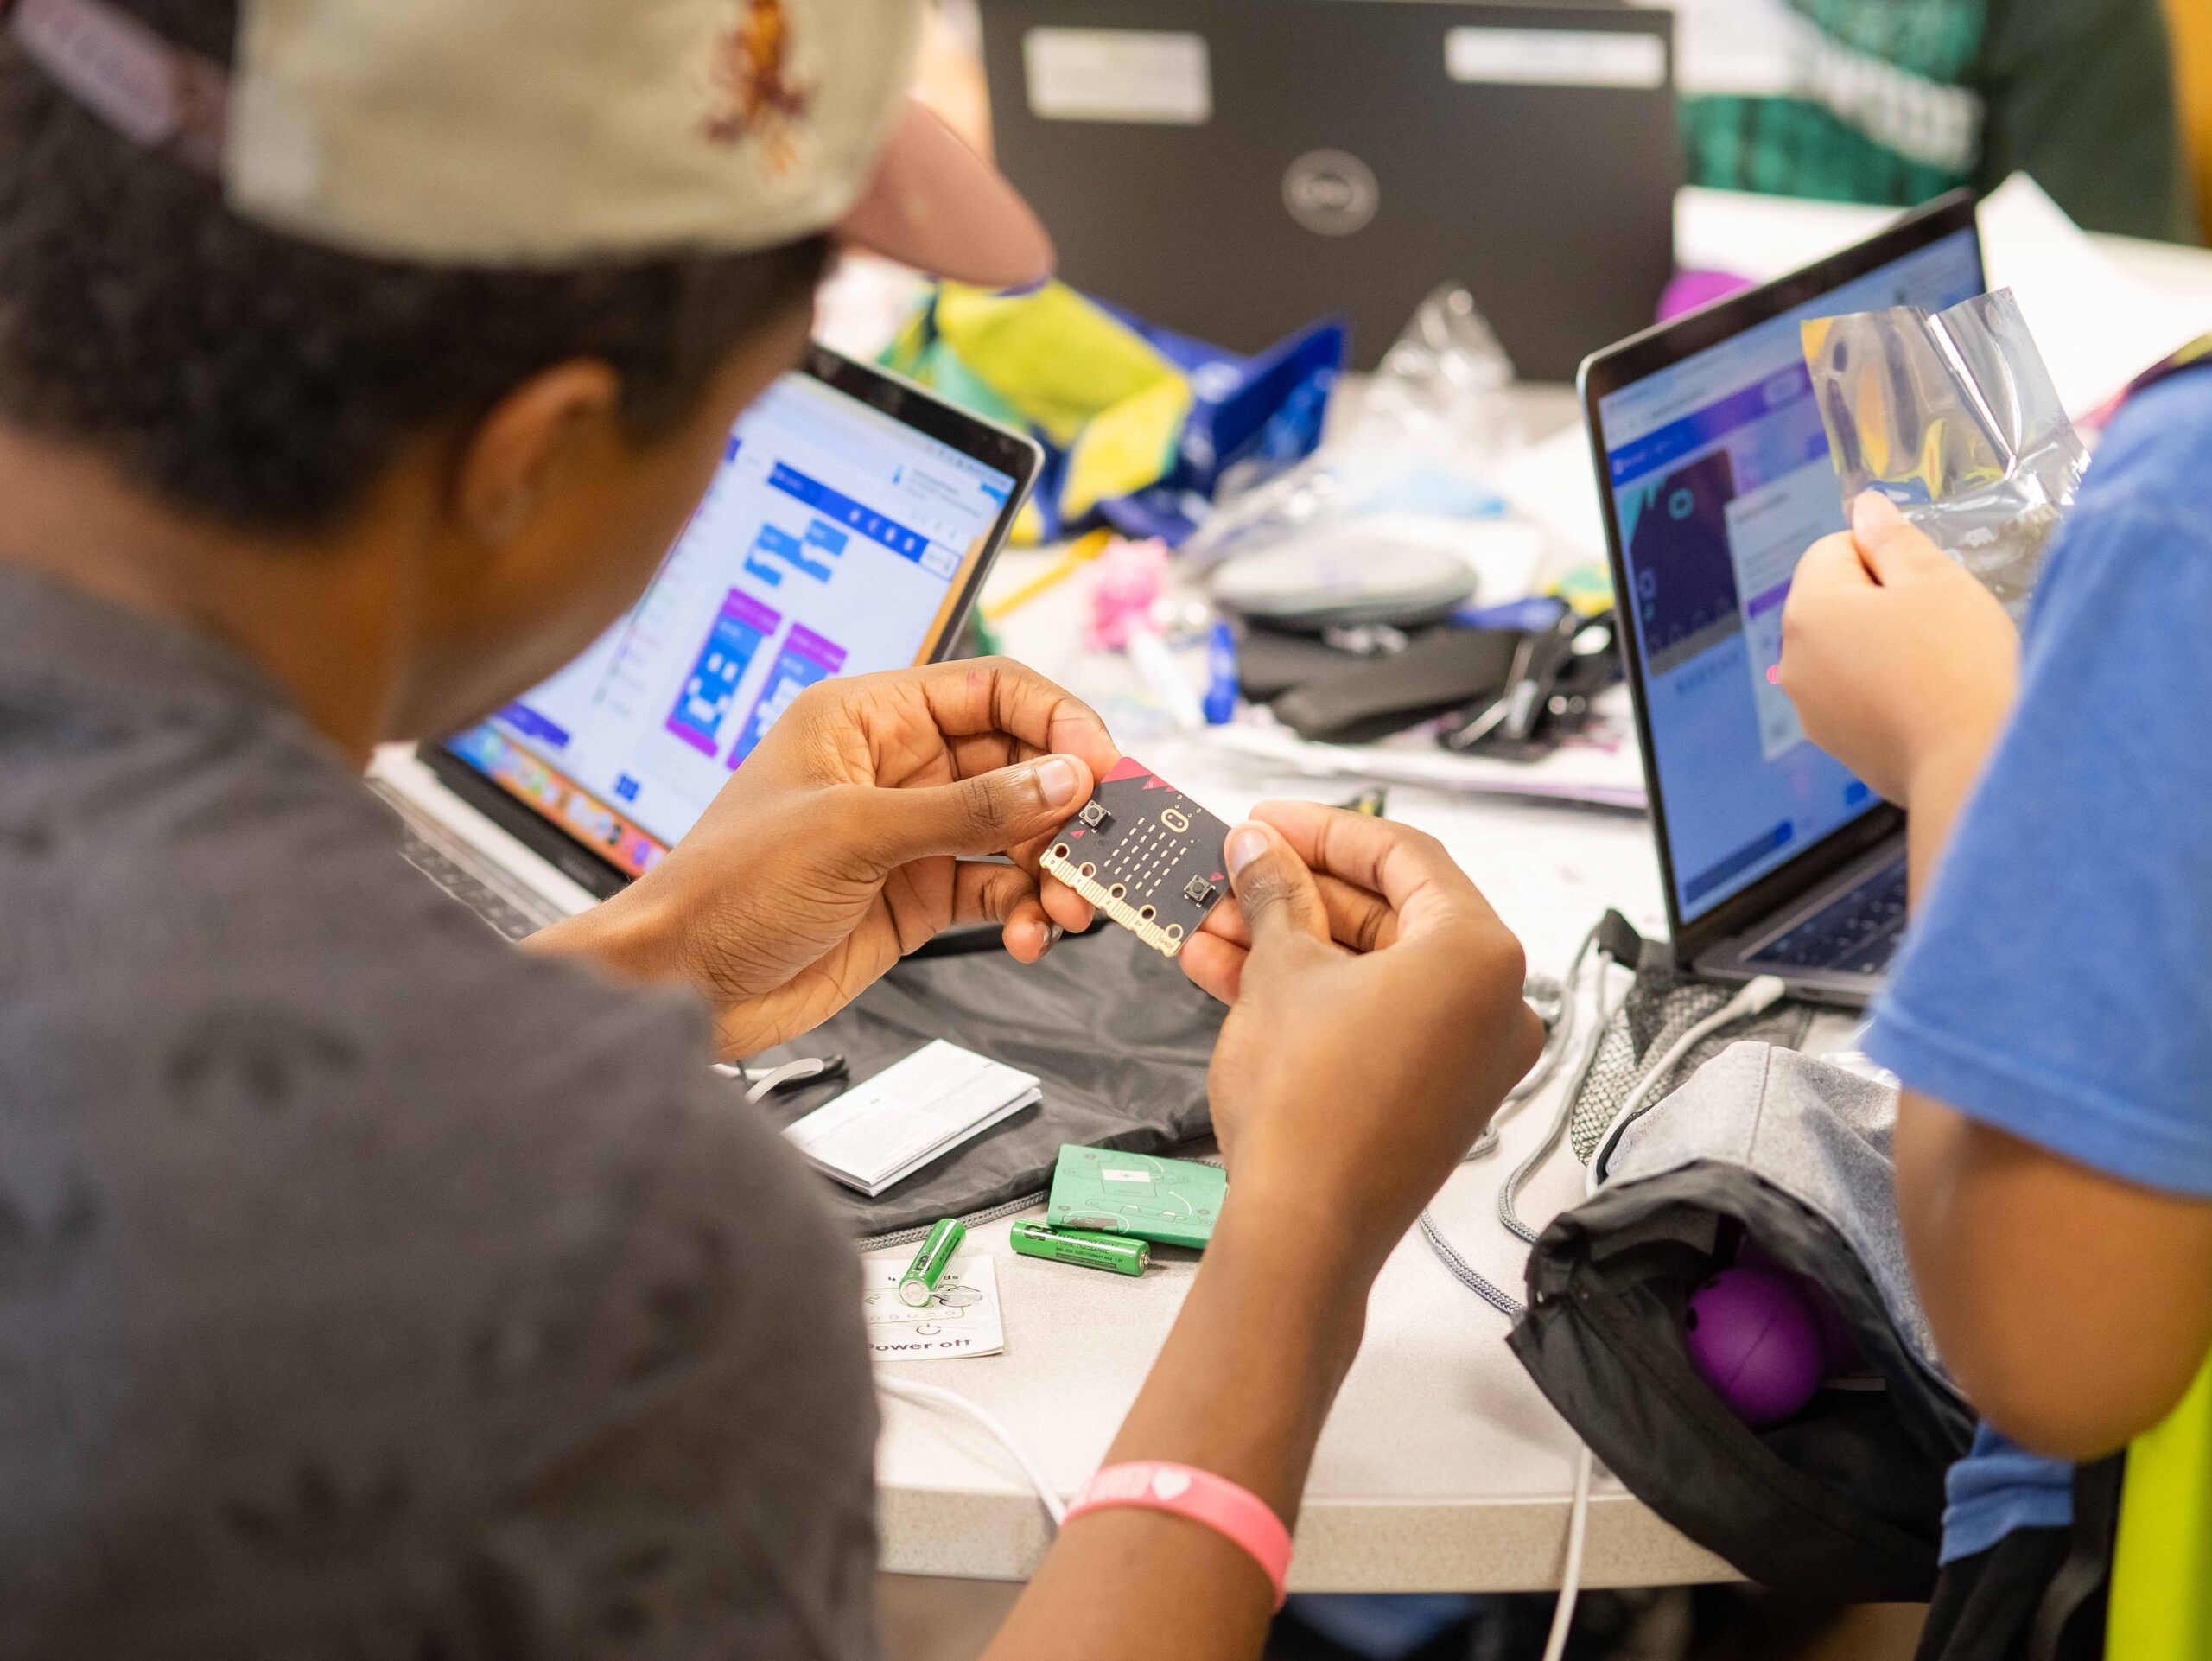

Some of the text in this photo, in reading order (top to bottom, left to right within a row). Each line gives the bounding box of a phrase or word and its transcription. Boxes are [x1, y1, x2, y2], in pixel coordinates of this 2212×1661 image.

[1134, 920, 1142, 928] 3V
[1159, 936, 1173, 950] GND
[1024, 1225, 1058, 1242] GP
[1058, 1232, 1077, 1241] EXTRA
[939, 1339, 972, 1348] off
